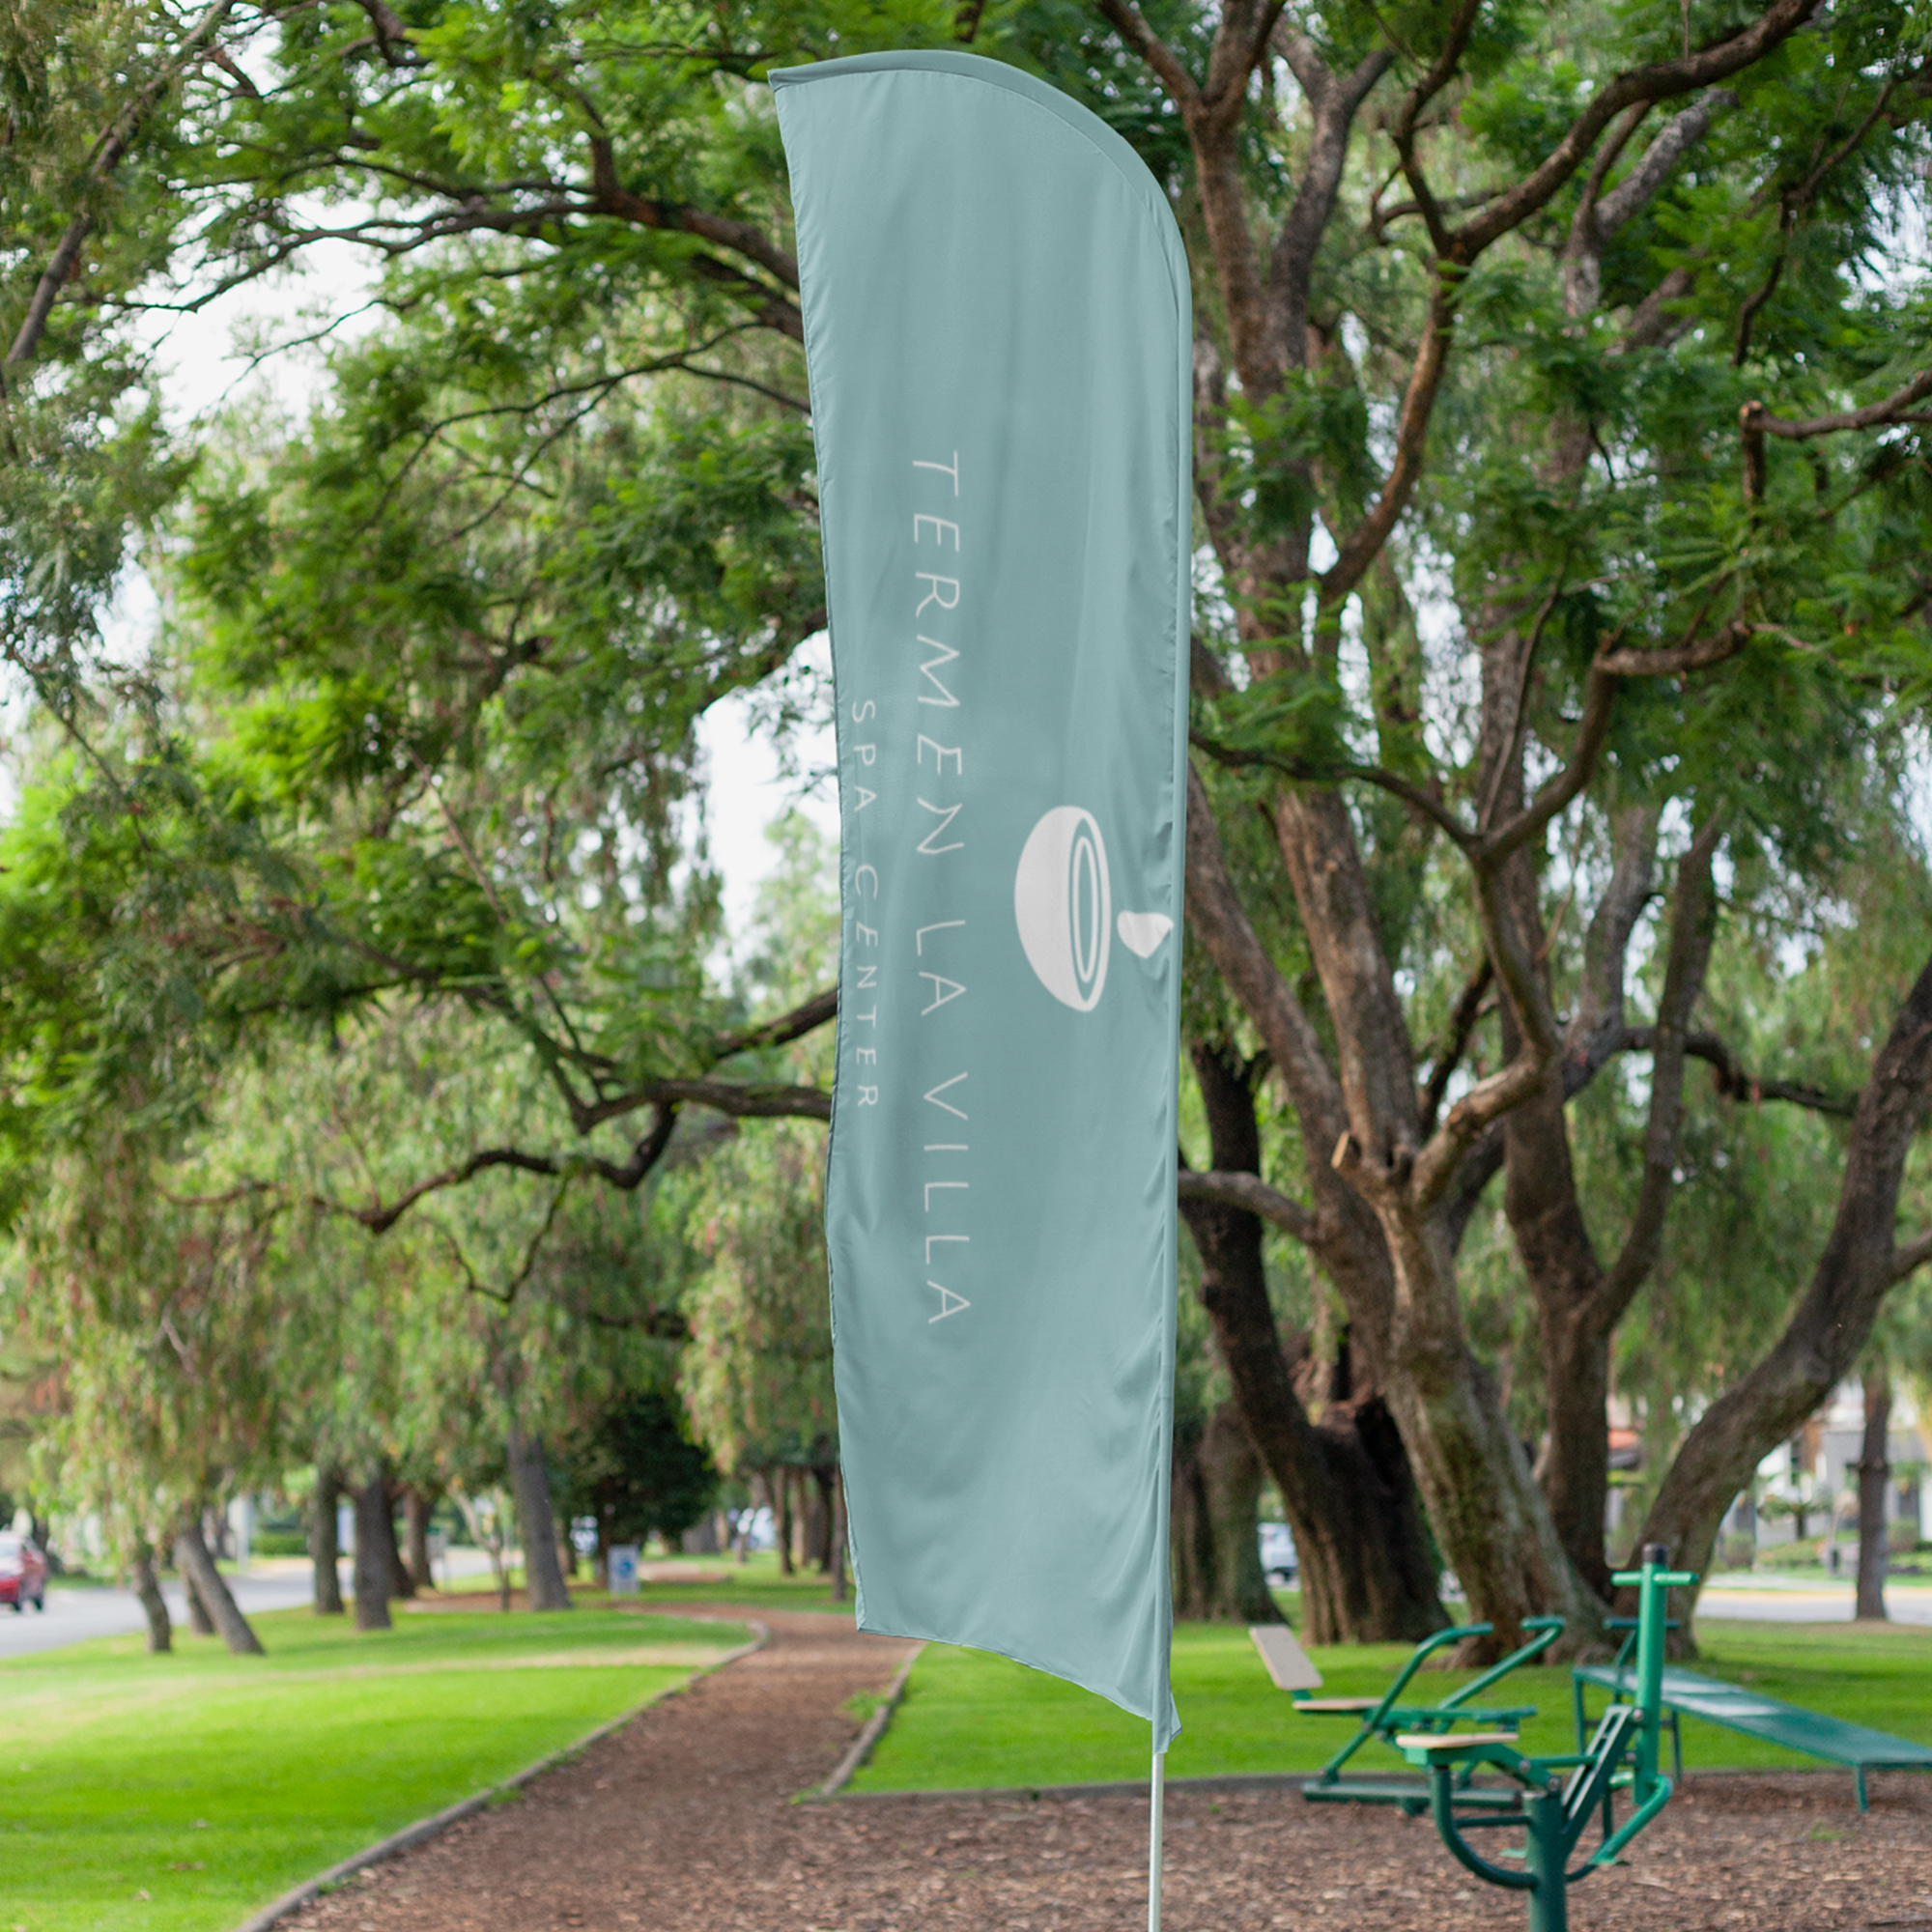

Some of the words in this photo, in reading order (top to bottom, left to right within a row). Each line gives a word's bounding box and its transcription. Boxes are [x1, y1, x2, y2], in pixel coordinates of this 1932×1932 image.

[852, 699, 877, 811] SPA
[912, 449, 964, 855] TERMEN
[854, 864, 878, 1107] CENTER
[916, 920, 967, 1016] LA
[923, 1071, 971, 1324] VILLA
